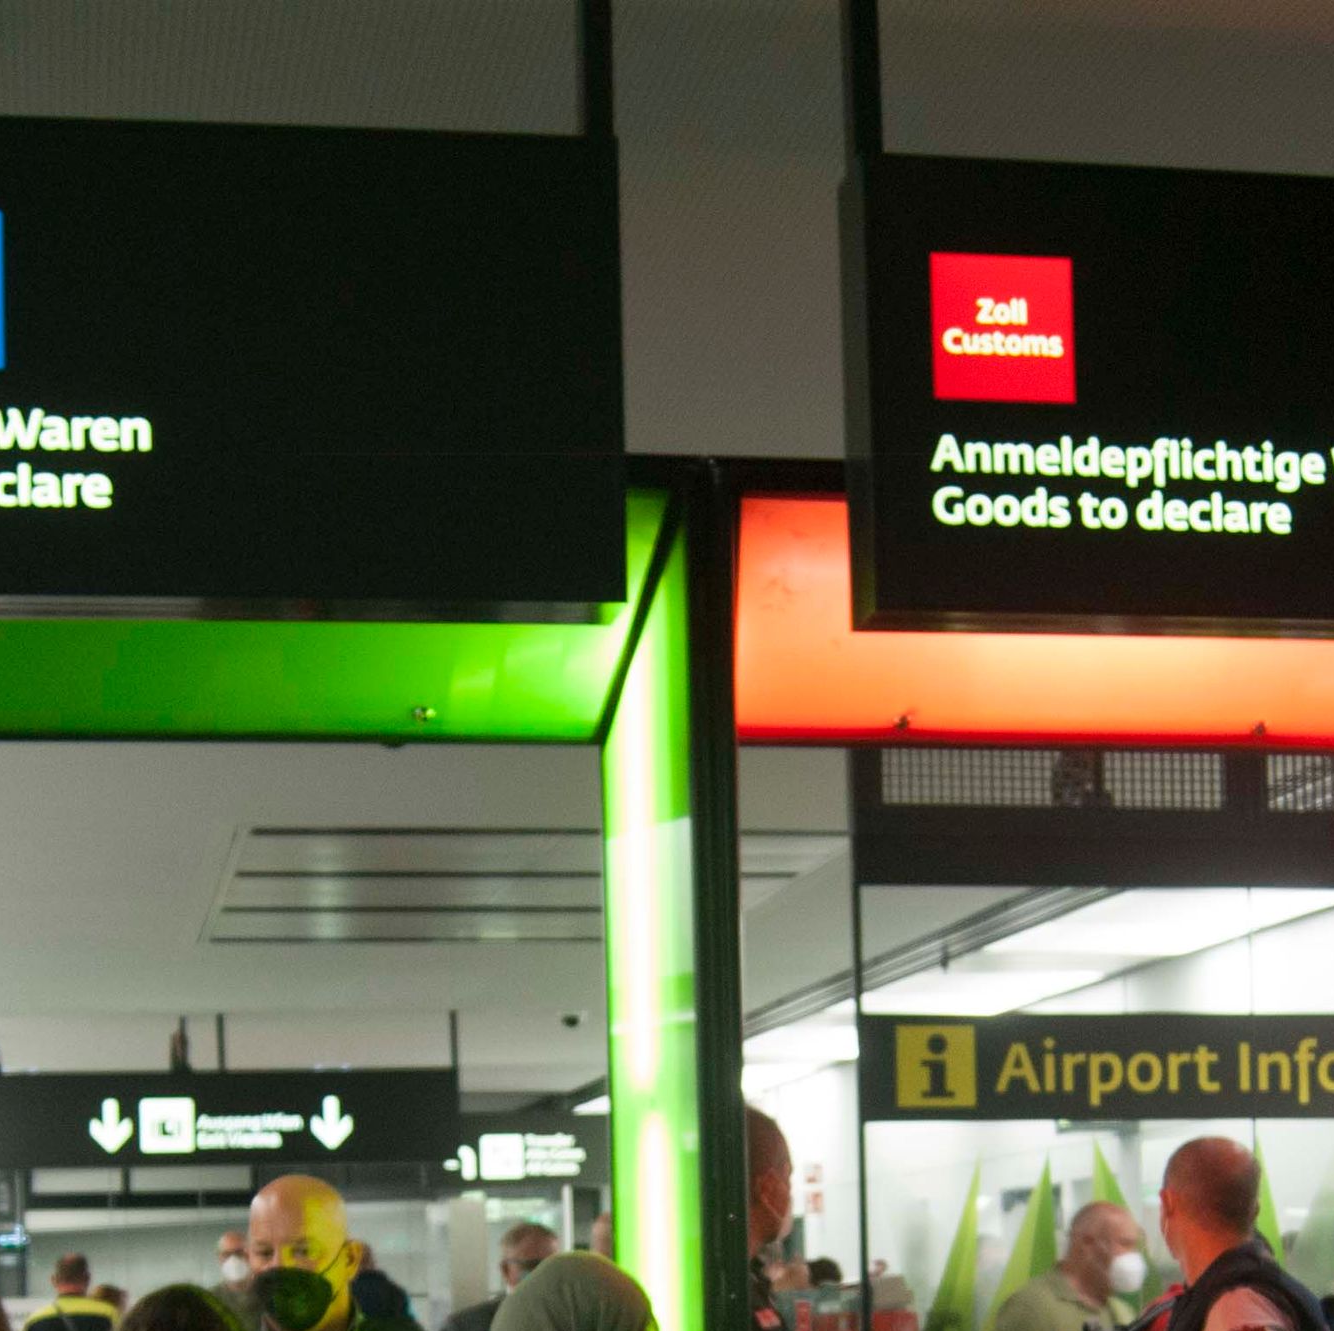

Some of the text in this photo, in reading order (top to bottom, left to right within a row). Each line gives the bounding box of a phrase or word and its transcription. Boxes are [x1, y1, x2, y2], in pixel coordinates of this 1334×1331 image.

[975, 297, 1028, 325] Zoll
[941, 327, 1064, 358] Customs
[930, 433, 1327, 493] Anmeldepflichtige
[931, 485, 1293, 535] Goods to declare
[996, 1037, 1221, 1107] Airport
